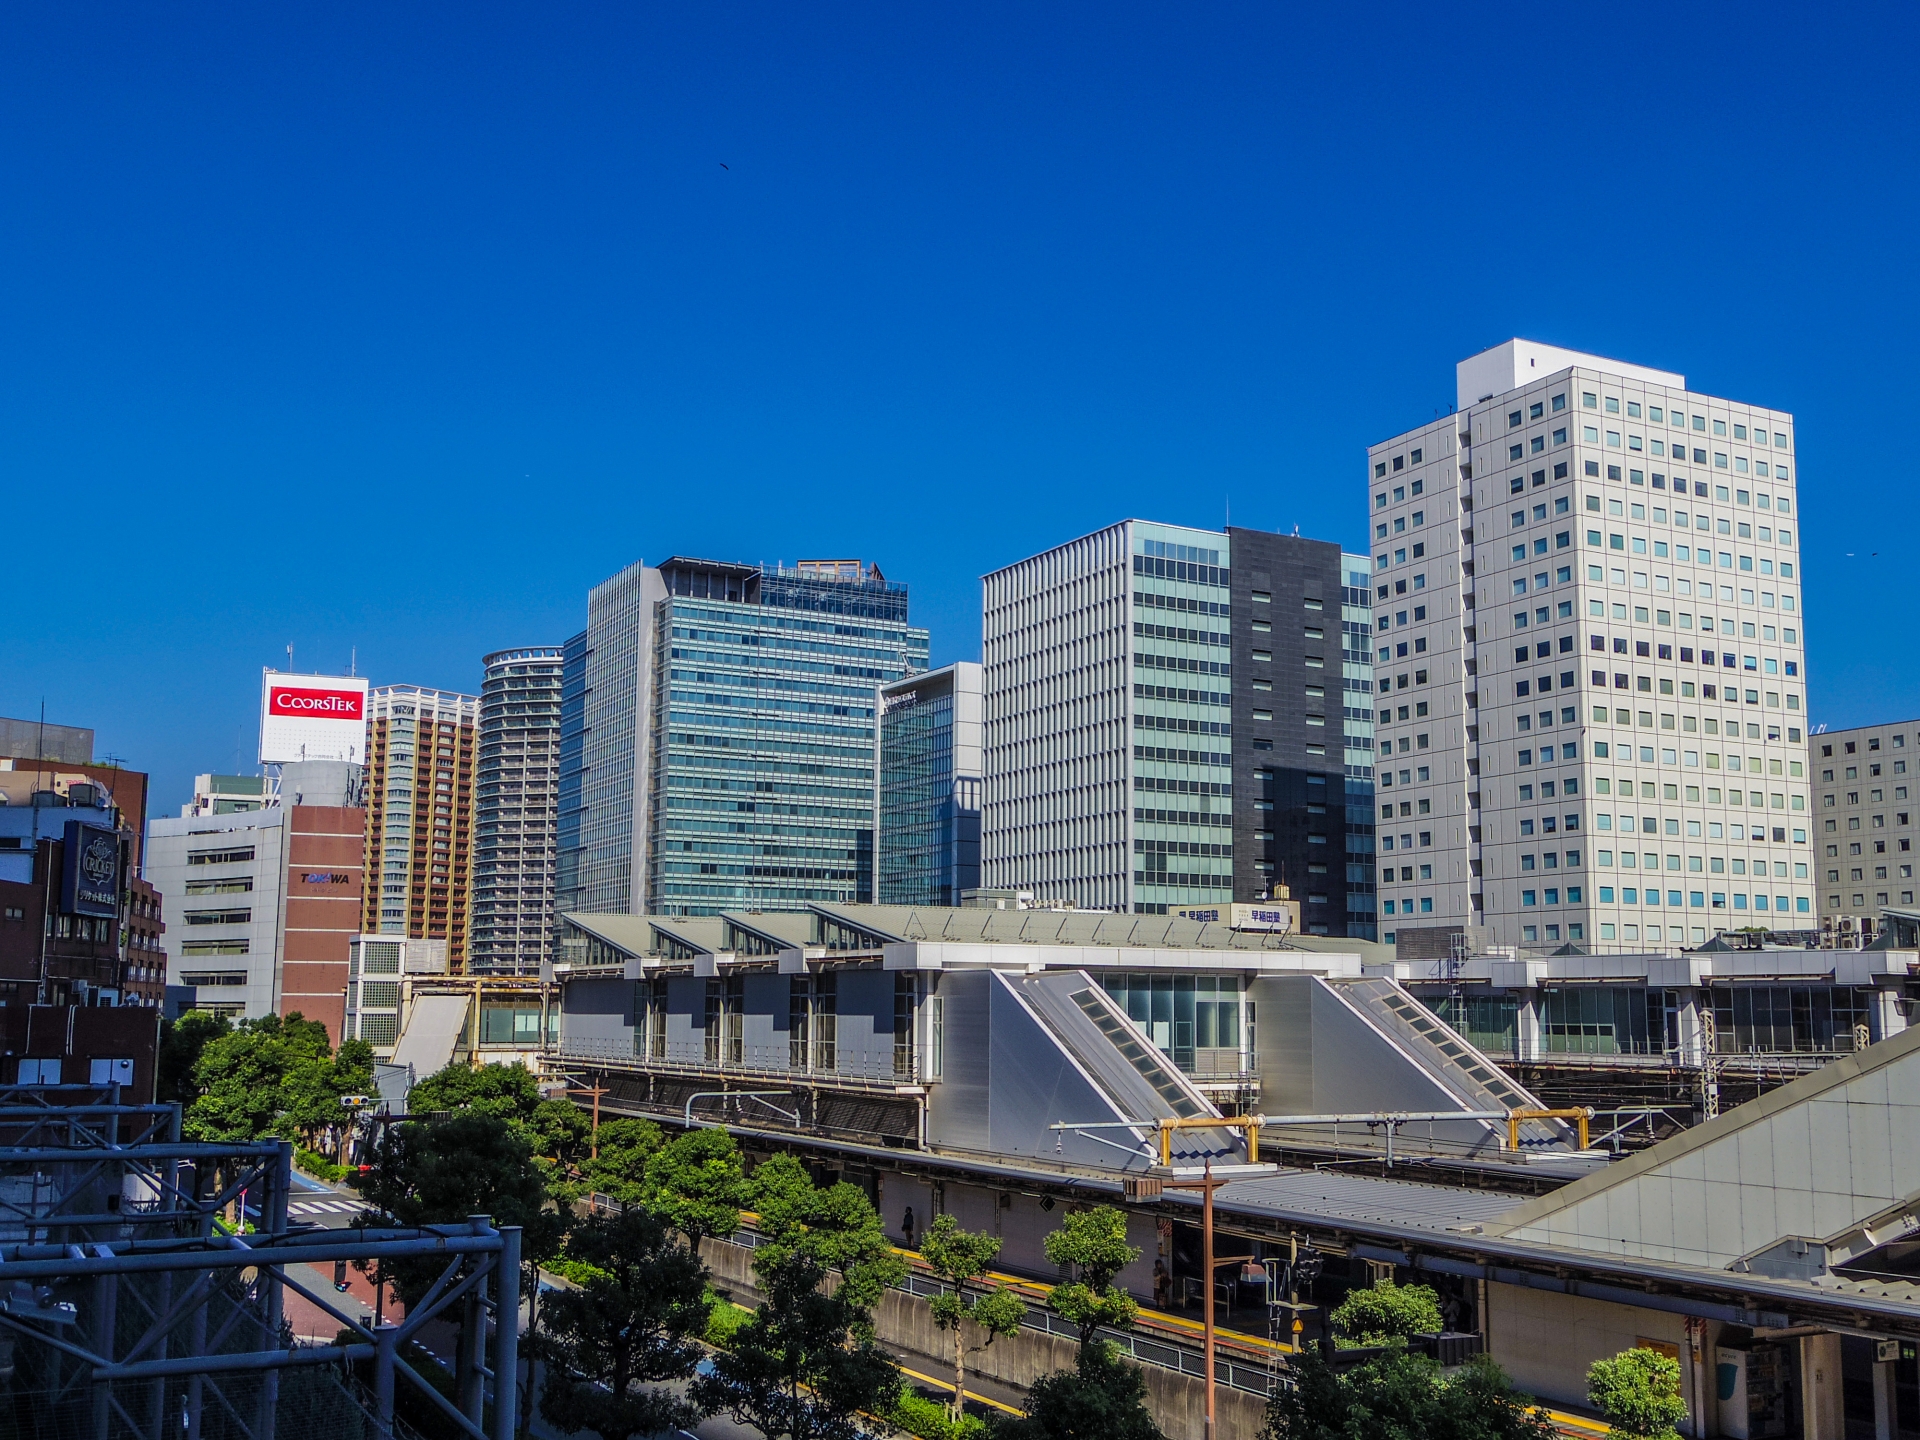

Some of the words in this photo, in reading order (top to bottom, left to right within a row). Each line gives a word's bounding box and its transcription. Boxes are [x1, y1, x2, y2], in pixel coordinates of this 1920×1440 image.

[85, 857, 115, 874] CRICKET
[1251, 910, 1281, 923] 早稲田塾
